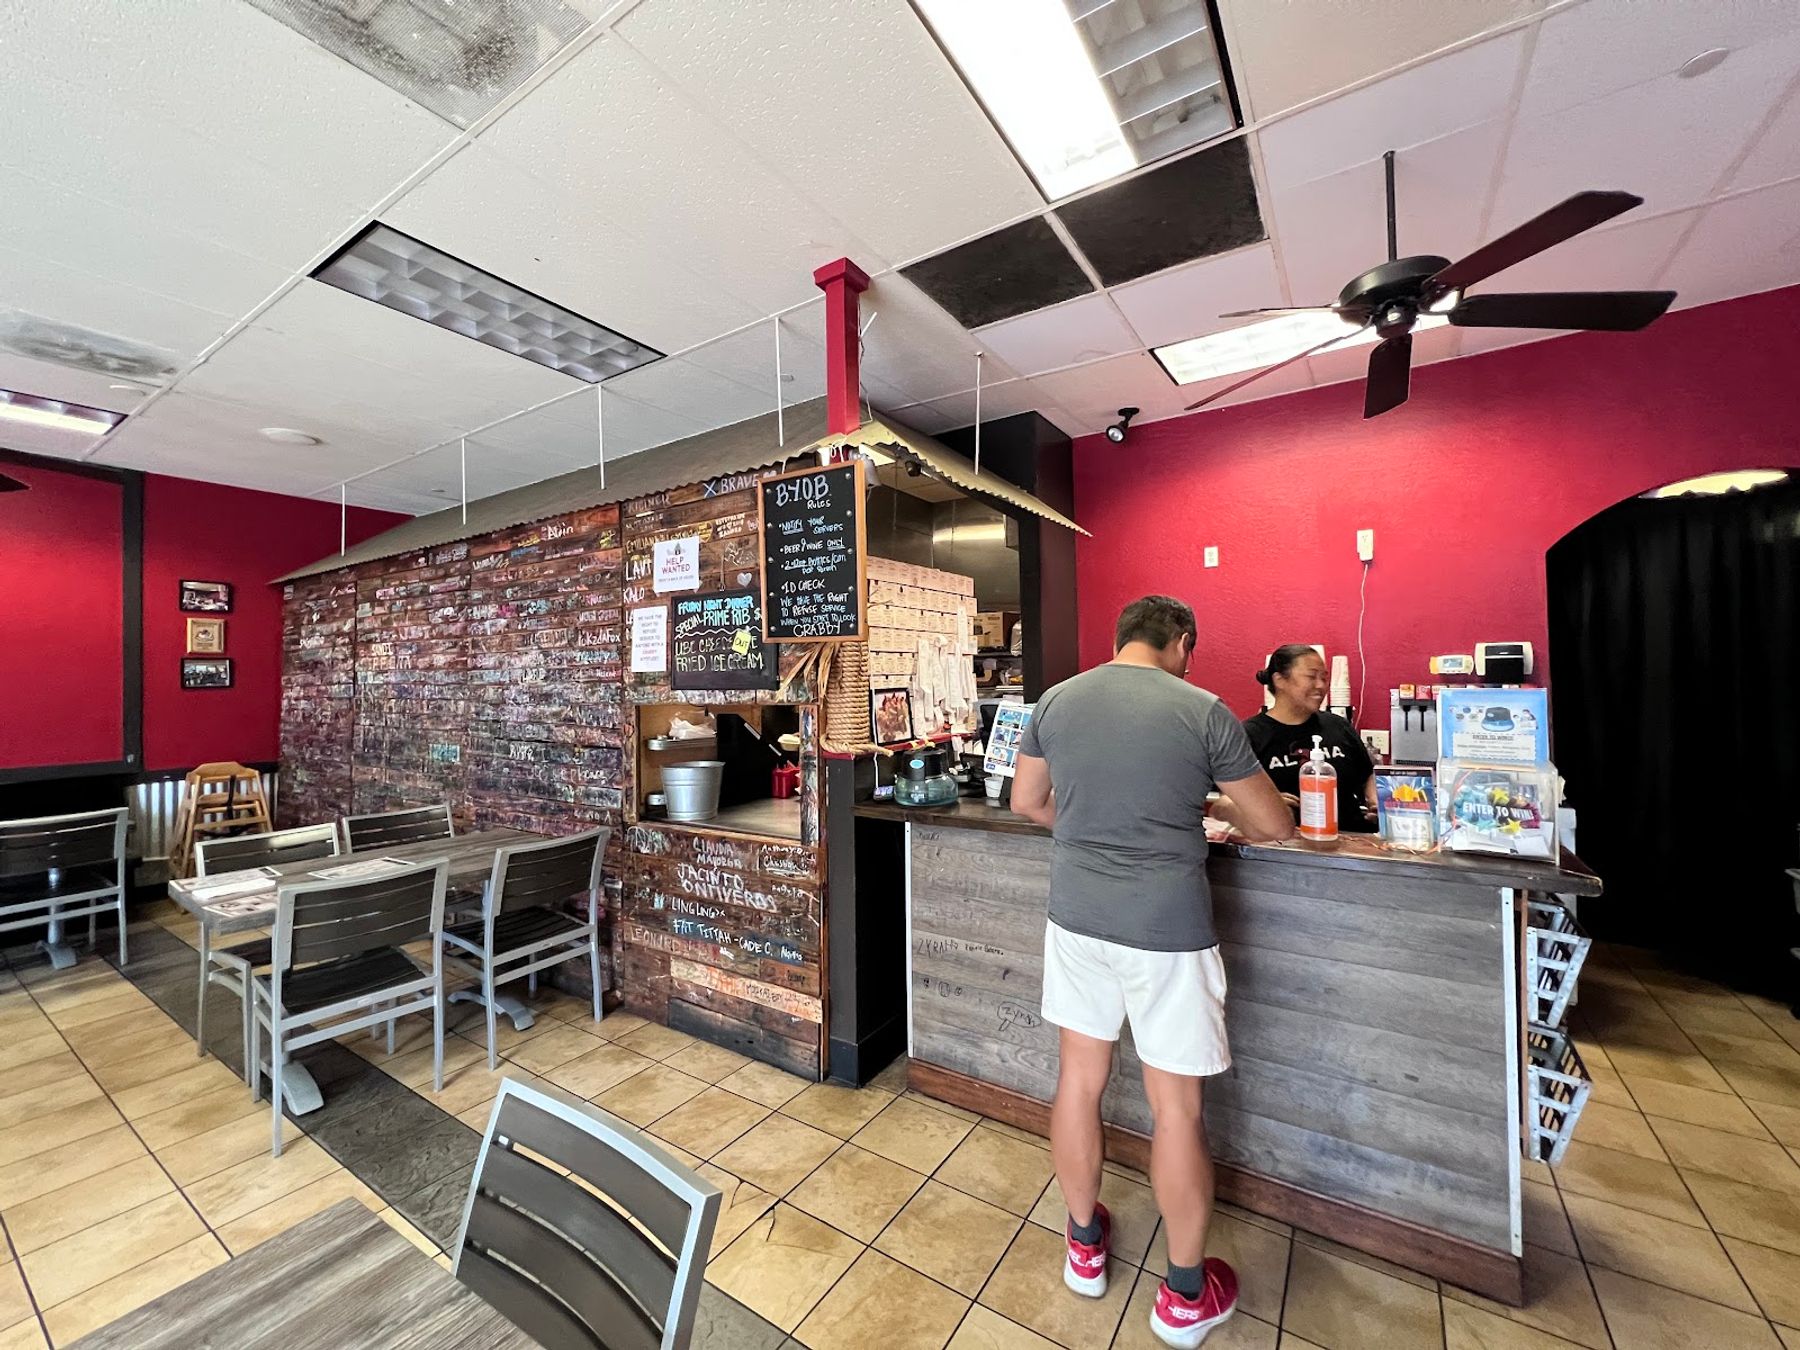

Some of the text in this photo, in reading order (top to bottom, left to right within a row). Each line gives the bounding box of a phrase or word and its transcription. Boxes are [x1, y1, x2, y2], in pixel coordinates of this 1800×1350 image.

[721, 473, 760, 494] BRAVE
[784, 543, 800, 555] BEER
[662, 563, 691, 575] WANTED
[665, 556, 684, 567] HELP
[798, 579, 826, 591] CHECK
[780, 596, 793, 607] WE
[827, 592, 849, 603] RIGHT
[703, 608, 730, 626] PRIME
[731, 607, 752, 626] RIB
[792, 604, 818, 617] REFUSE
[793, 620, 841, 637] CRABBY
[676, 652, 764, 672] FRIED ICE CREAM
[1269, 745, 1345, 769] ALHA
[1462, 801, 1494, 815] ENTER
[1496, 806, 1509, 818] TO
[677, 863, 745, 891] JACINTO
[682, 879, 778, 913] ONTIVEROS
